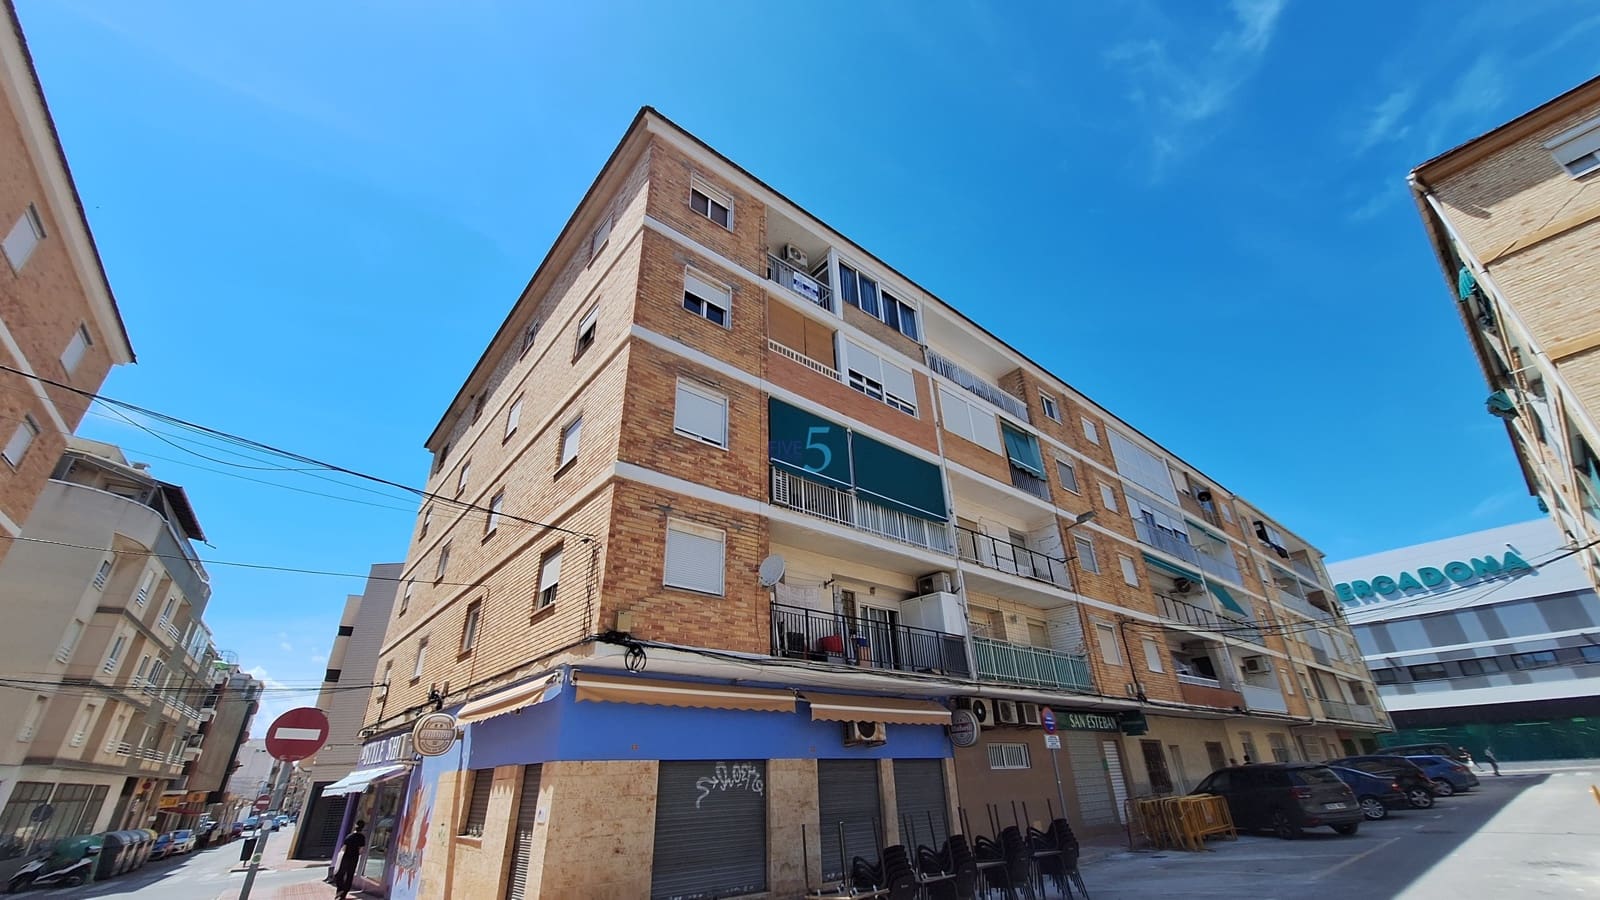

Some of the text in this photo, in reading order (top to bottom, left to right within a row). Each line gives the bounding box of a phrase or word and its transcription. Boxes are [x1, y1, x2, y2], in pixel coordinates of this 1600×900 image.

[1334, 551, 1532, 601] ERCADONA
[1069, 713, 1118, 729] SAN ESTEBAN
